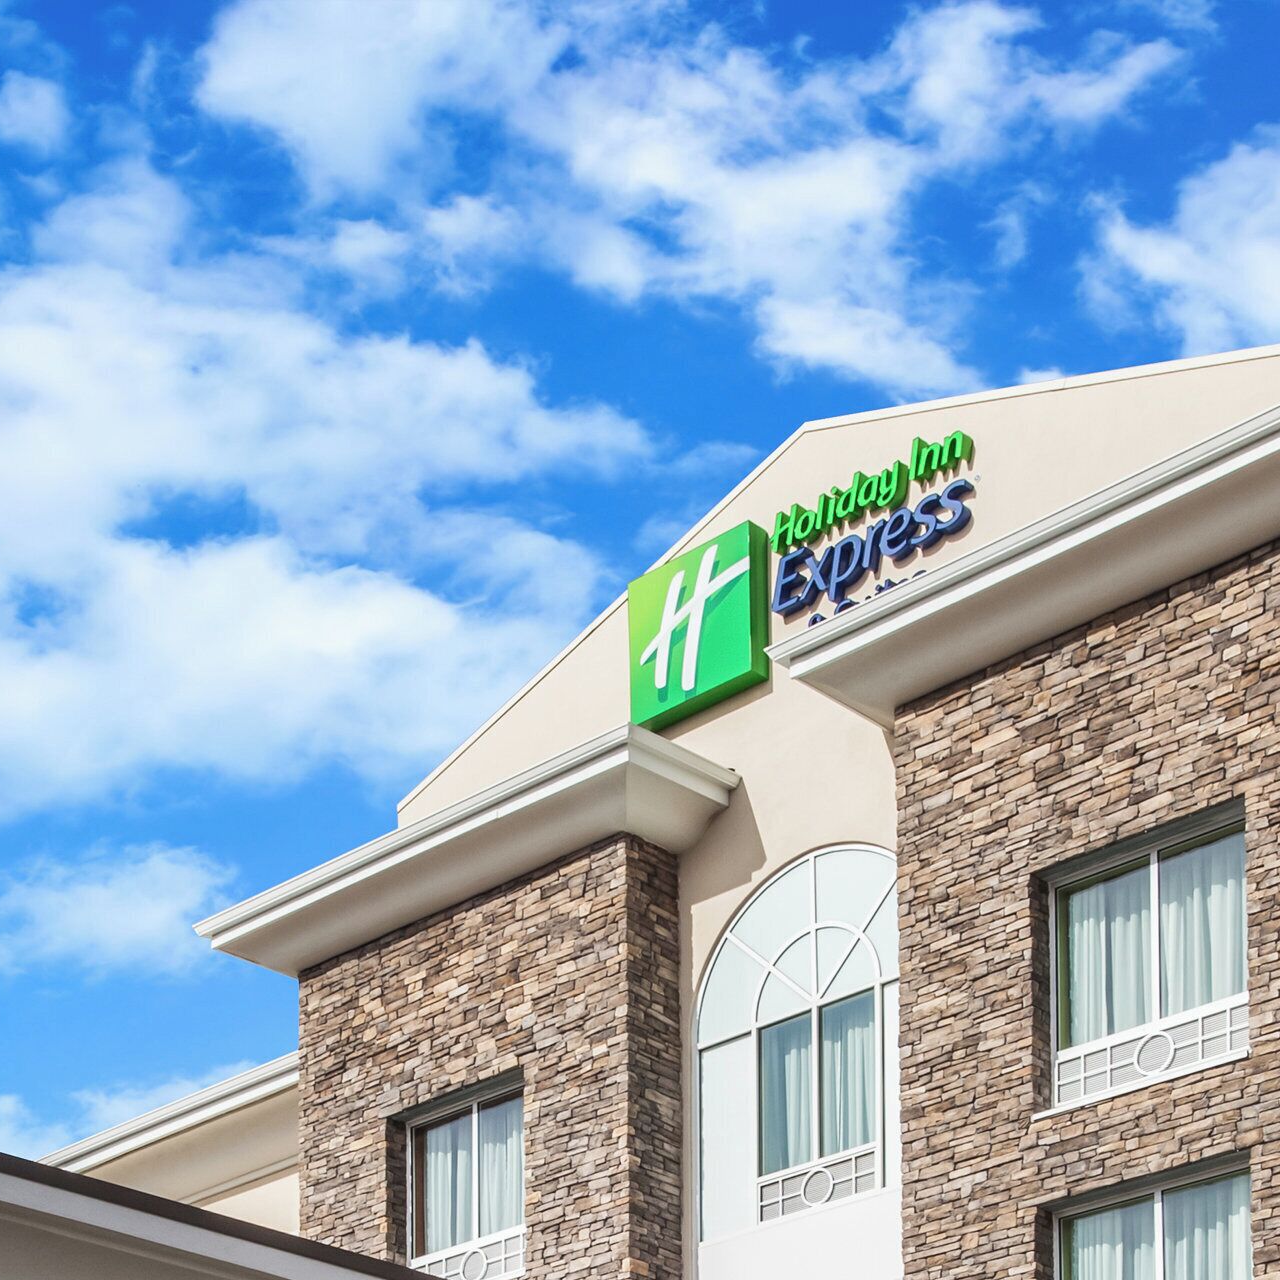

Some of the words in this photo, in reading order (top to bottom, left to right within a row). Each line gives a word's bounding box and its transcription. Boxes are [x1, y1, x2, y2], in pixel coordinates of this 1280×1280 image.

[771, 460, 909, 555] Holiday
[909, 431, 974, 483] Inn
[771, 479, 975, 616] Express
